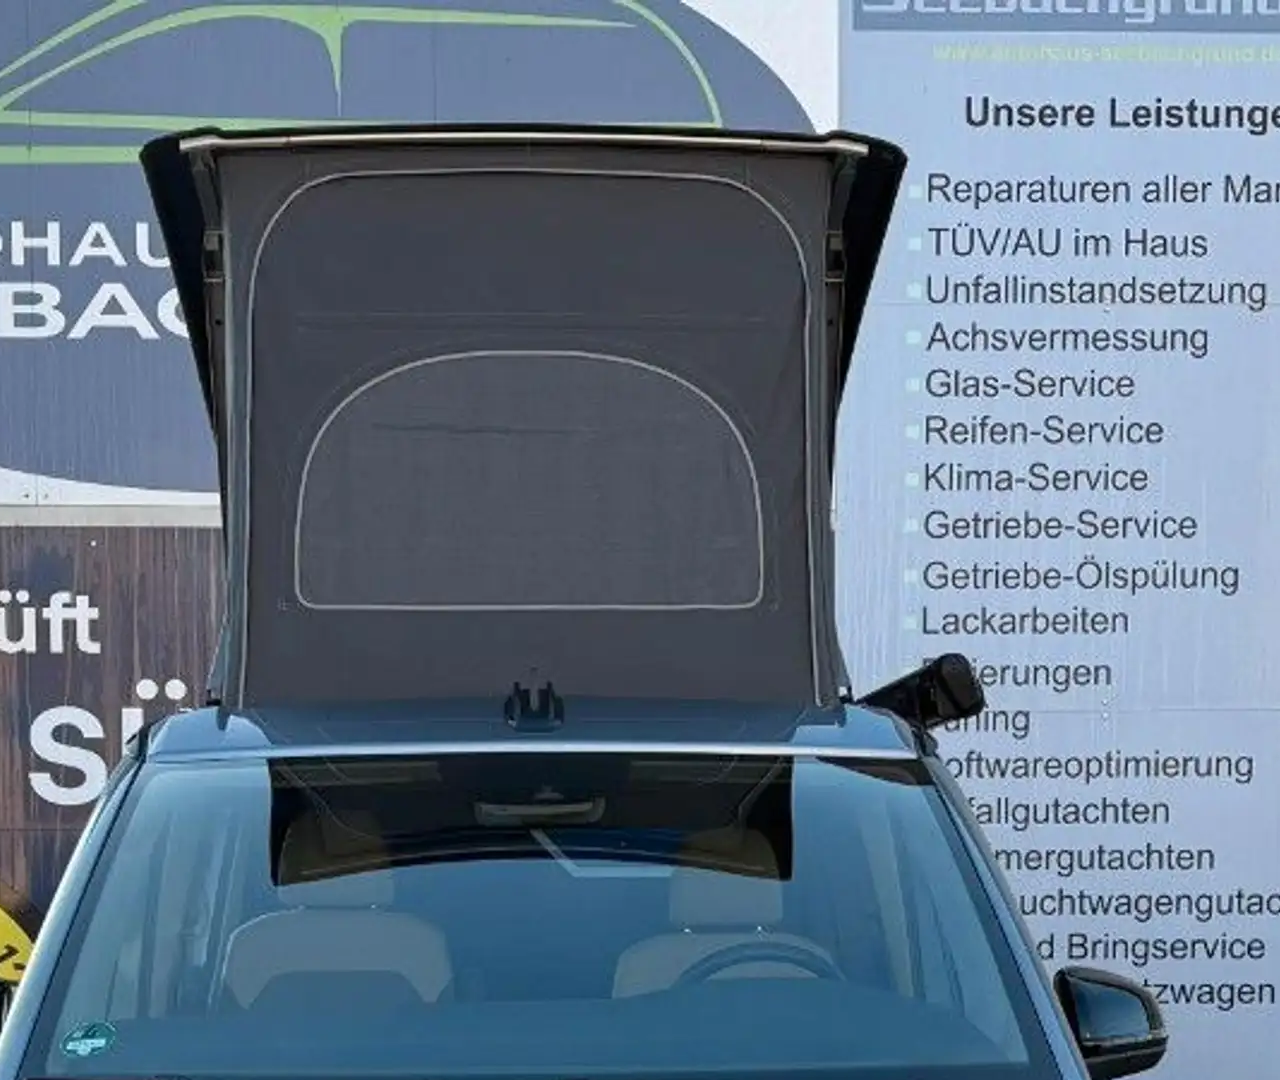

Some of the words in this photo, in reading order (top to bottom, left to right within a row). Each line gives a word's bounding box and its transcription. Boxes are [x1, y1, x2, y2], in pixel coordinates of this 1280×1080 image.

[965, 96, 1096, 129] Unsere
[926, 172, 1131, 209] Reparaturen
[1141, 174, 1213, 204] aller
[927, 222, 1061, 258] TÜV/AU
[1073, 227, 1111, 257] im
[1123, 227, 1209, 258] Haus
[925, 274, 1268, 312] Unfallinstandsetzung
[926, 321, 1209, 359] Achsvermessung
[924, 367, 1136, 399] Glas-Service
[924, 413, 1165, 446] Reifen-Service
[923, 462, 1149, 493] Klima-Service
[923, 507, 1199, 540] Getriebe-Service
[922, 554, 1240, 596] Getriebe-Ölspülung
[922, 605, 1130, 636] Lackarbeiten
[945, 749, 1255, 785] oftwareoptimierung
[970, 796, 1170, 832] allgutachten
[1066, 933, 1267, 968] Bringservice
